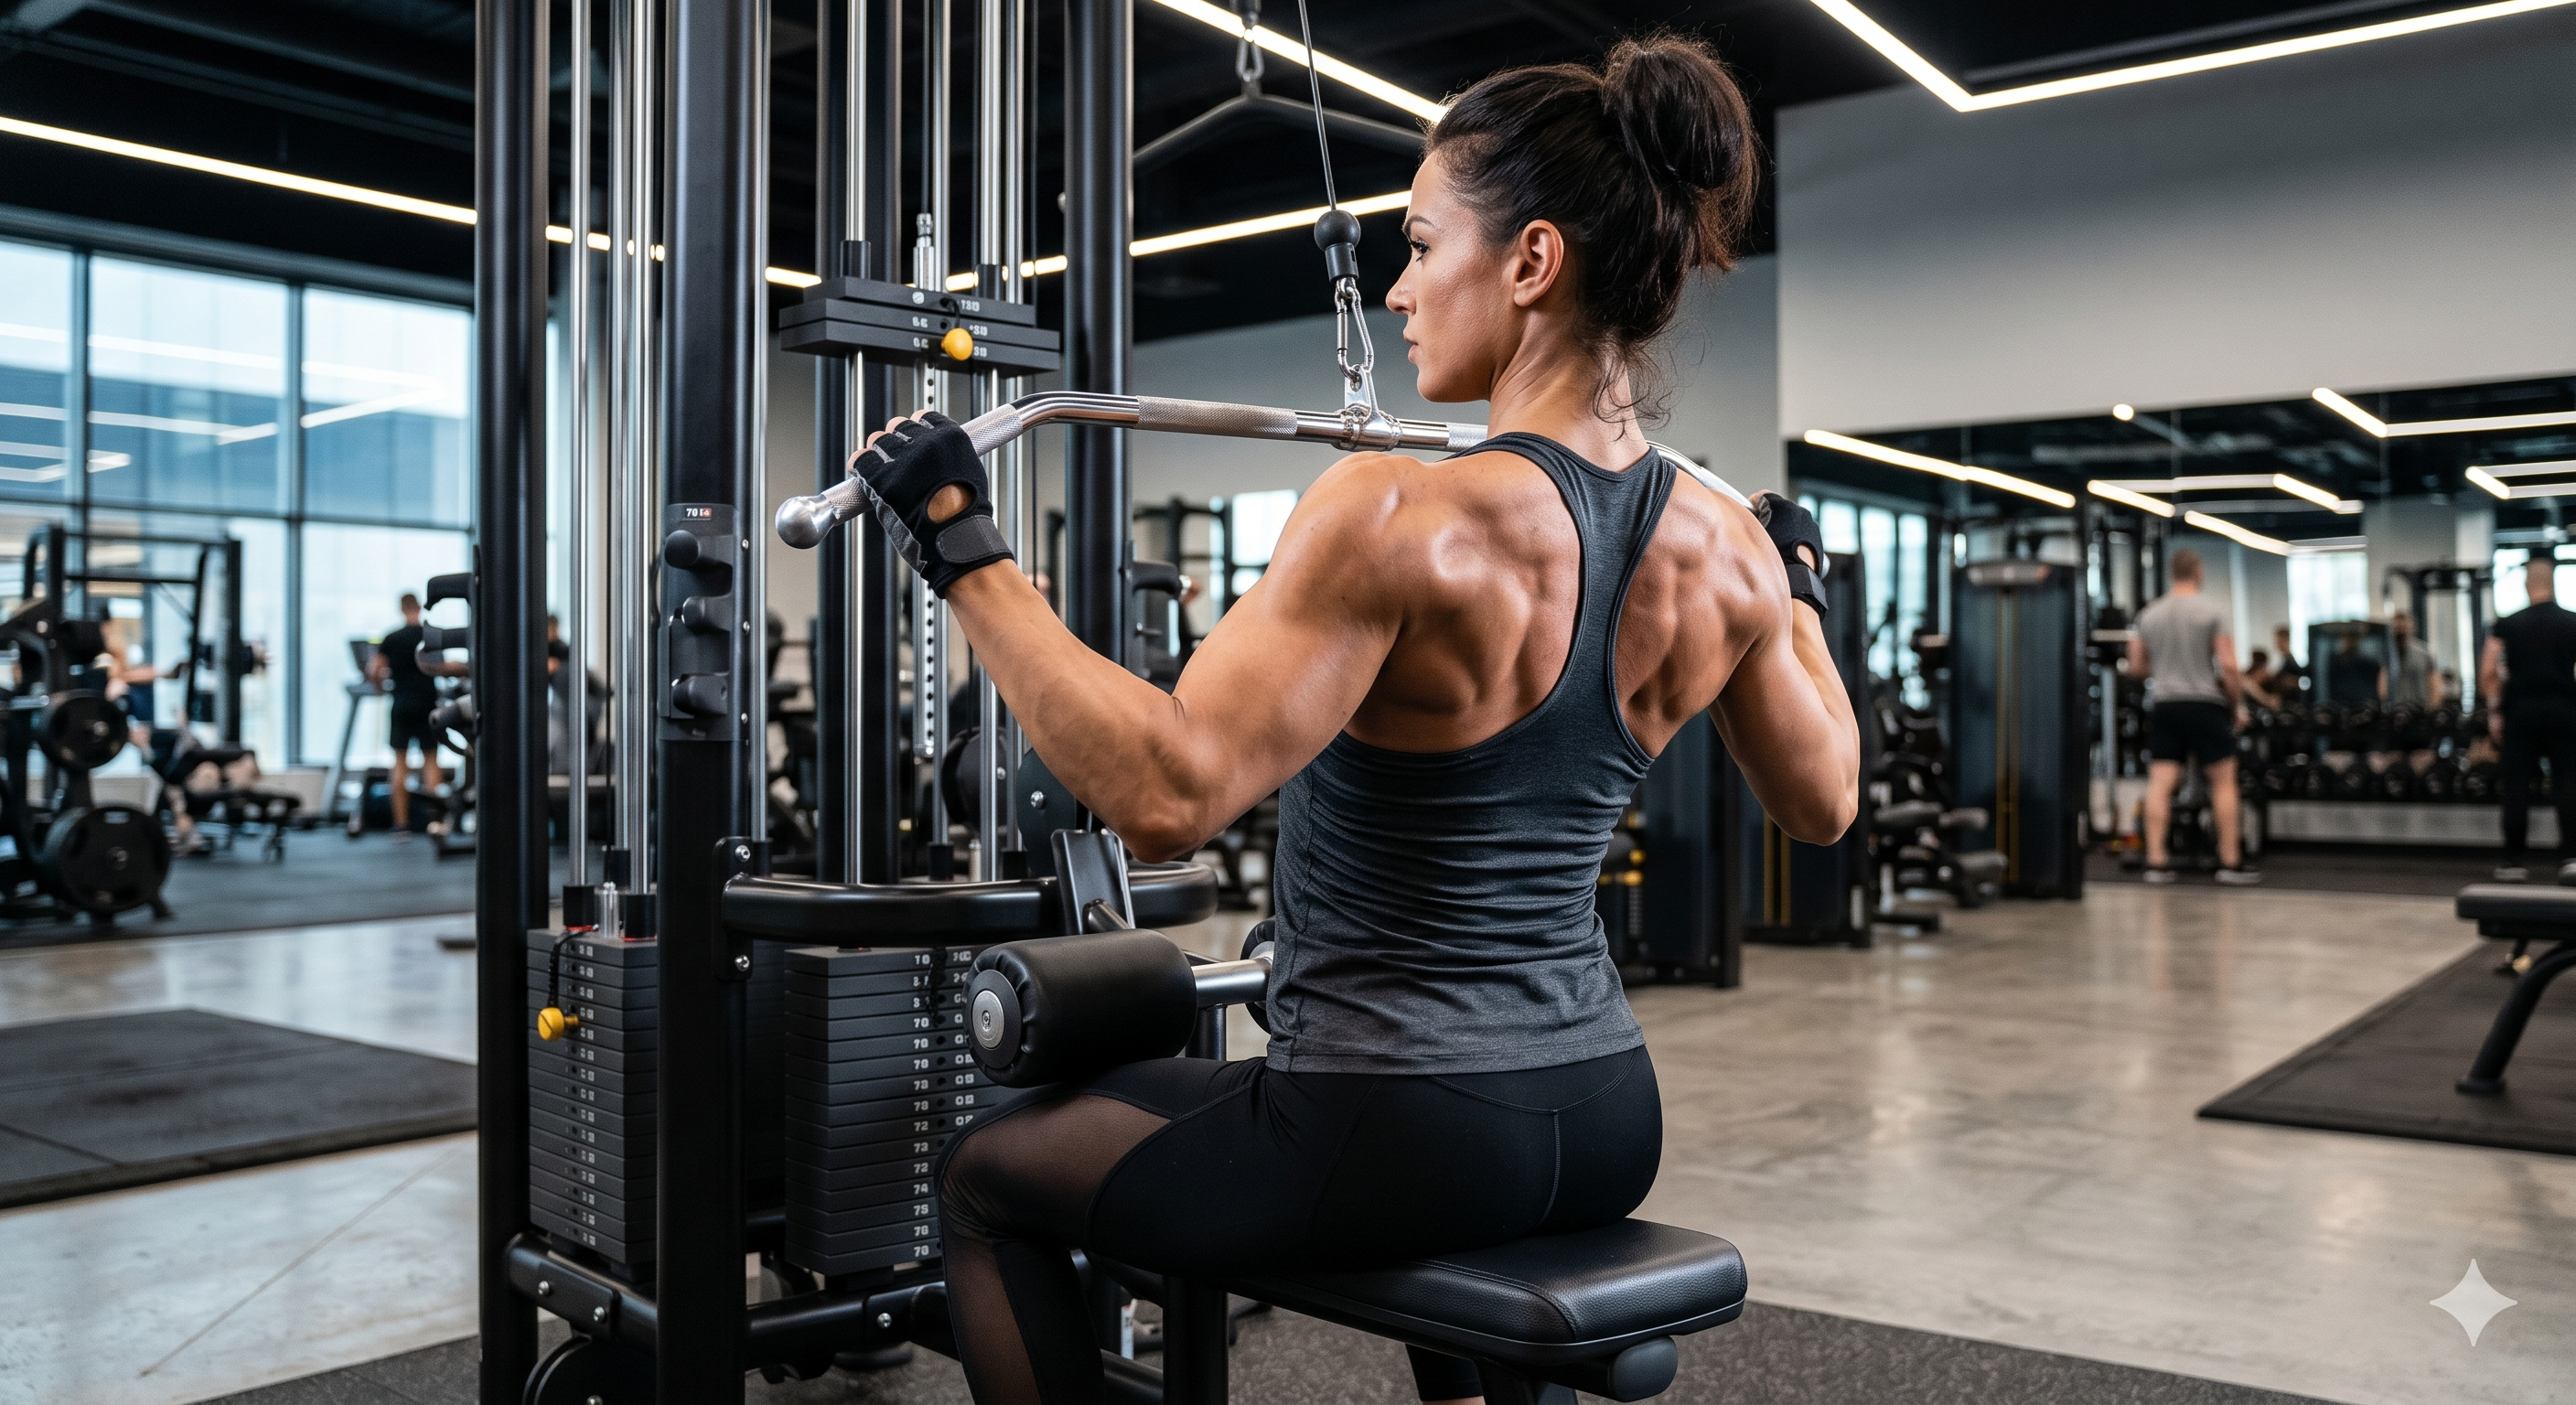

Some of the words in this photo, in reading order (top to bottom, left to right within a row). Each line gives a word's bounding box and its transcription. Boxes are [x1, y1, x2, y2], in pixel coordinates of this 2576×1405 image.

[686, 508, 698, 517] 70
[914, 1121, 928, 1132] 72
[914, 1162, 928, 1174] 72
[914, 1183, 928, 1195] 74
